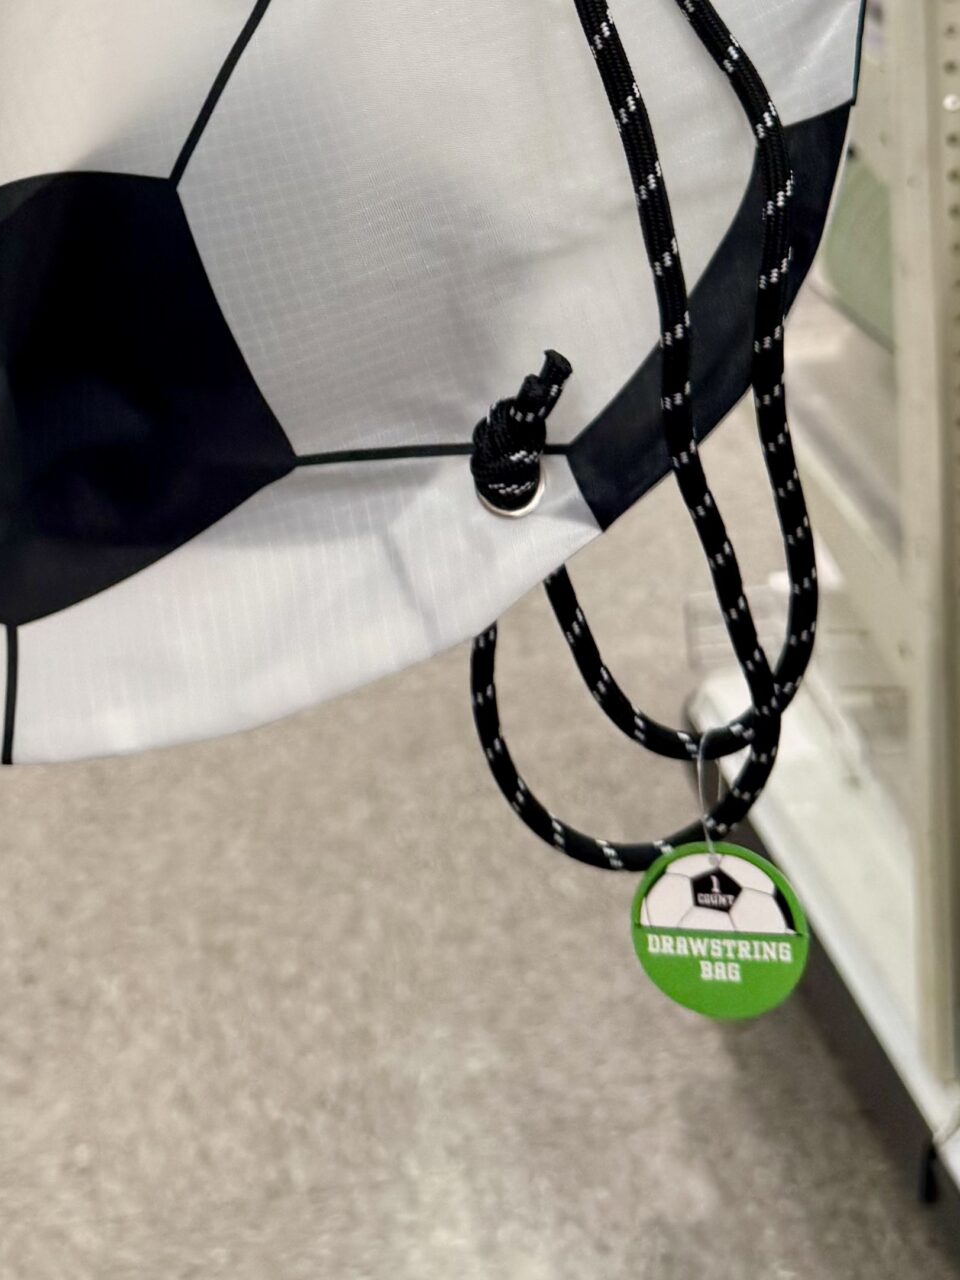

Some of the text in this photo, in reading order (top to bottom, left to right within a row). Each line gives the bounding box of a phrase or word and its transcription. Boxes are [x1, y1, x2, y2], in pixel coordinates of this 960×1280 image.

[710, 875, 720, 892] 1
[697, 893, 735, 906] COUNT
[646, 934, 792, 962] DRAWSTRING
[700, 961, 741, 983] BAG
